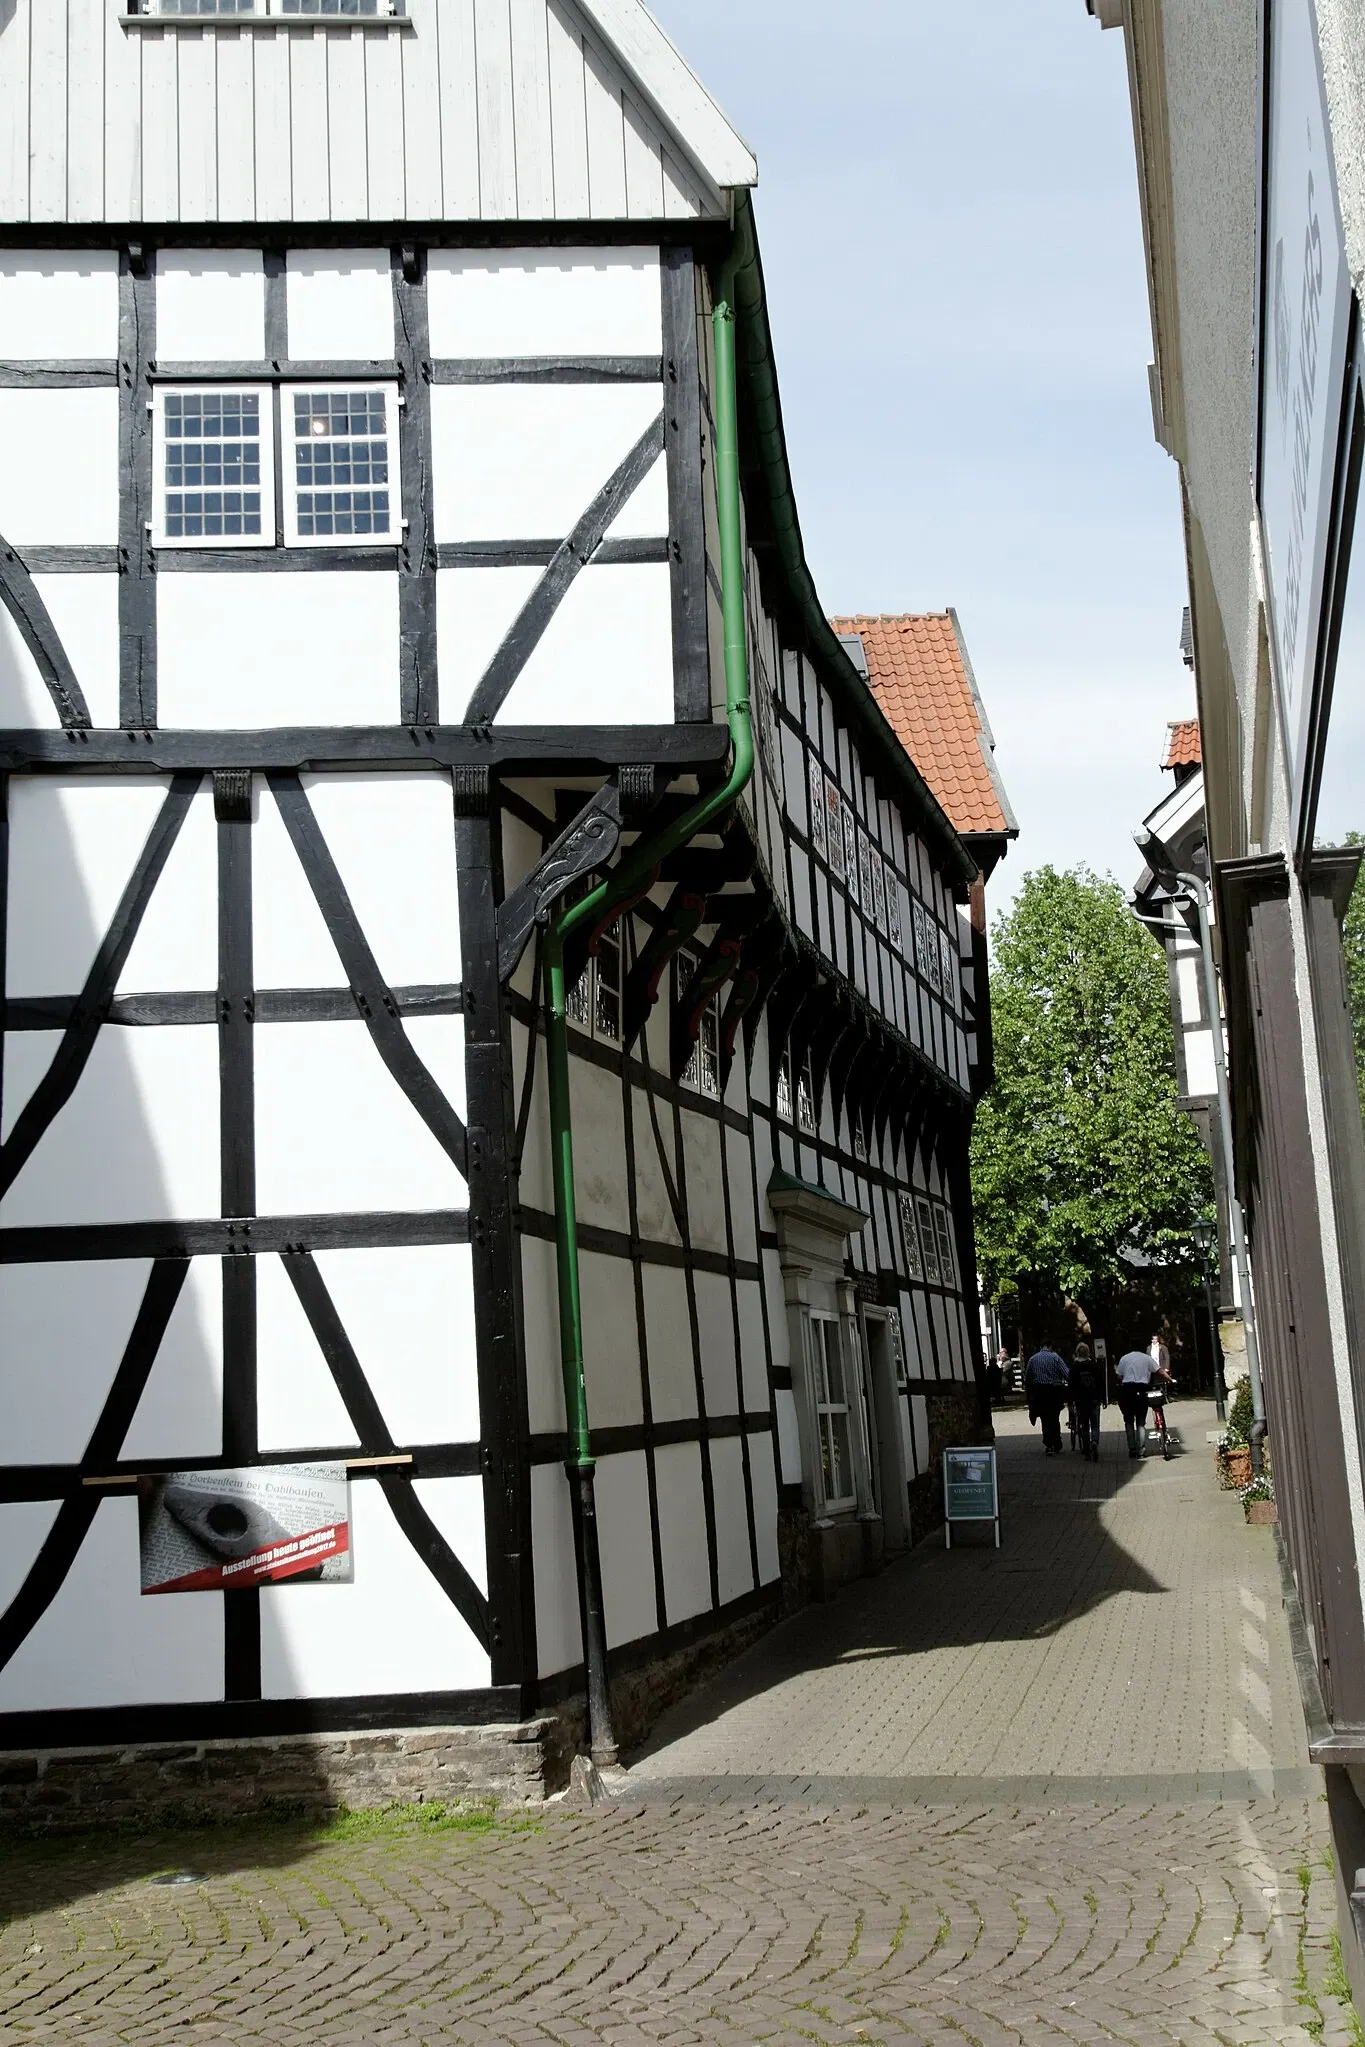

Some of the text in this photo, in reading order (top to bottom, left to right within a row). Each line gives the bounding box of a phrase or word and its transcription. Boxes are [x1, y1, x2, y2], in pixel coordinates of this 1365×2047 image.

[1283, 545, 1299, 709] ENGEL
[1292, 169, 1323, 542] VÖLKERS
[246, 1480, 260, 1490] bei
[222, 1528, 335, 1576] Ausstellung heute geöffnet
